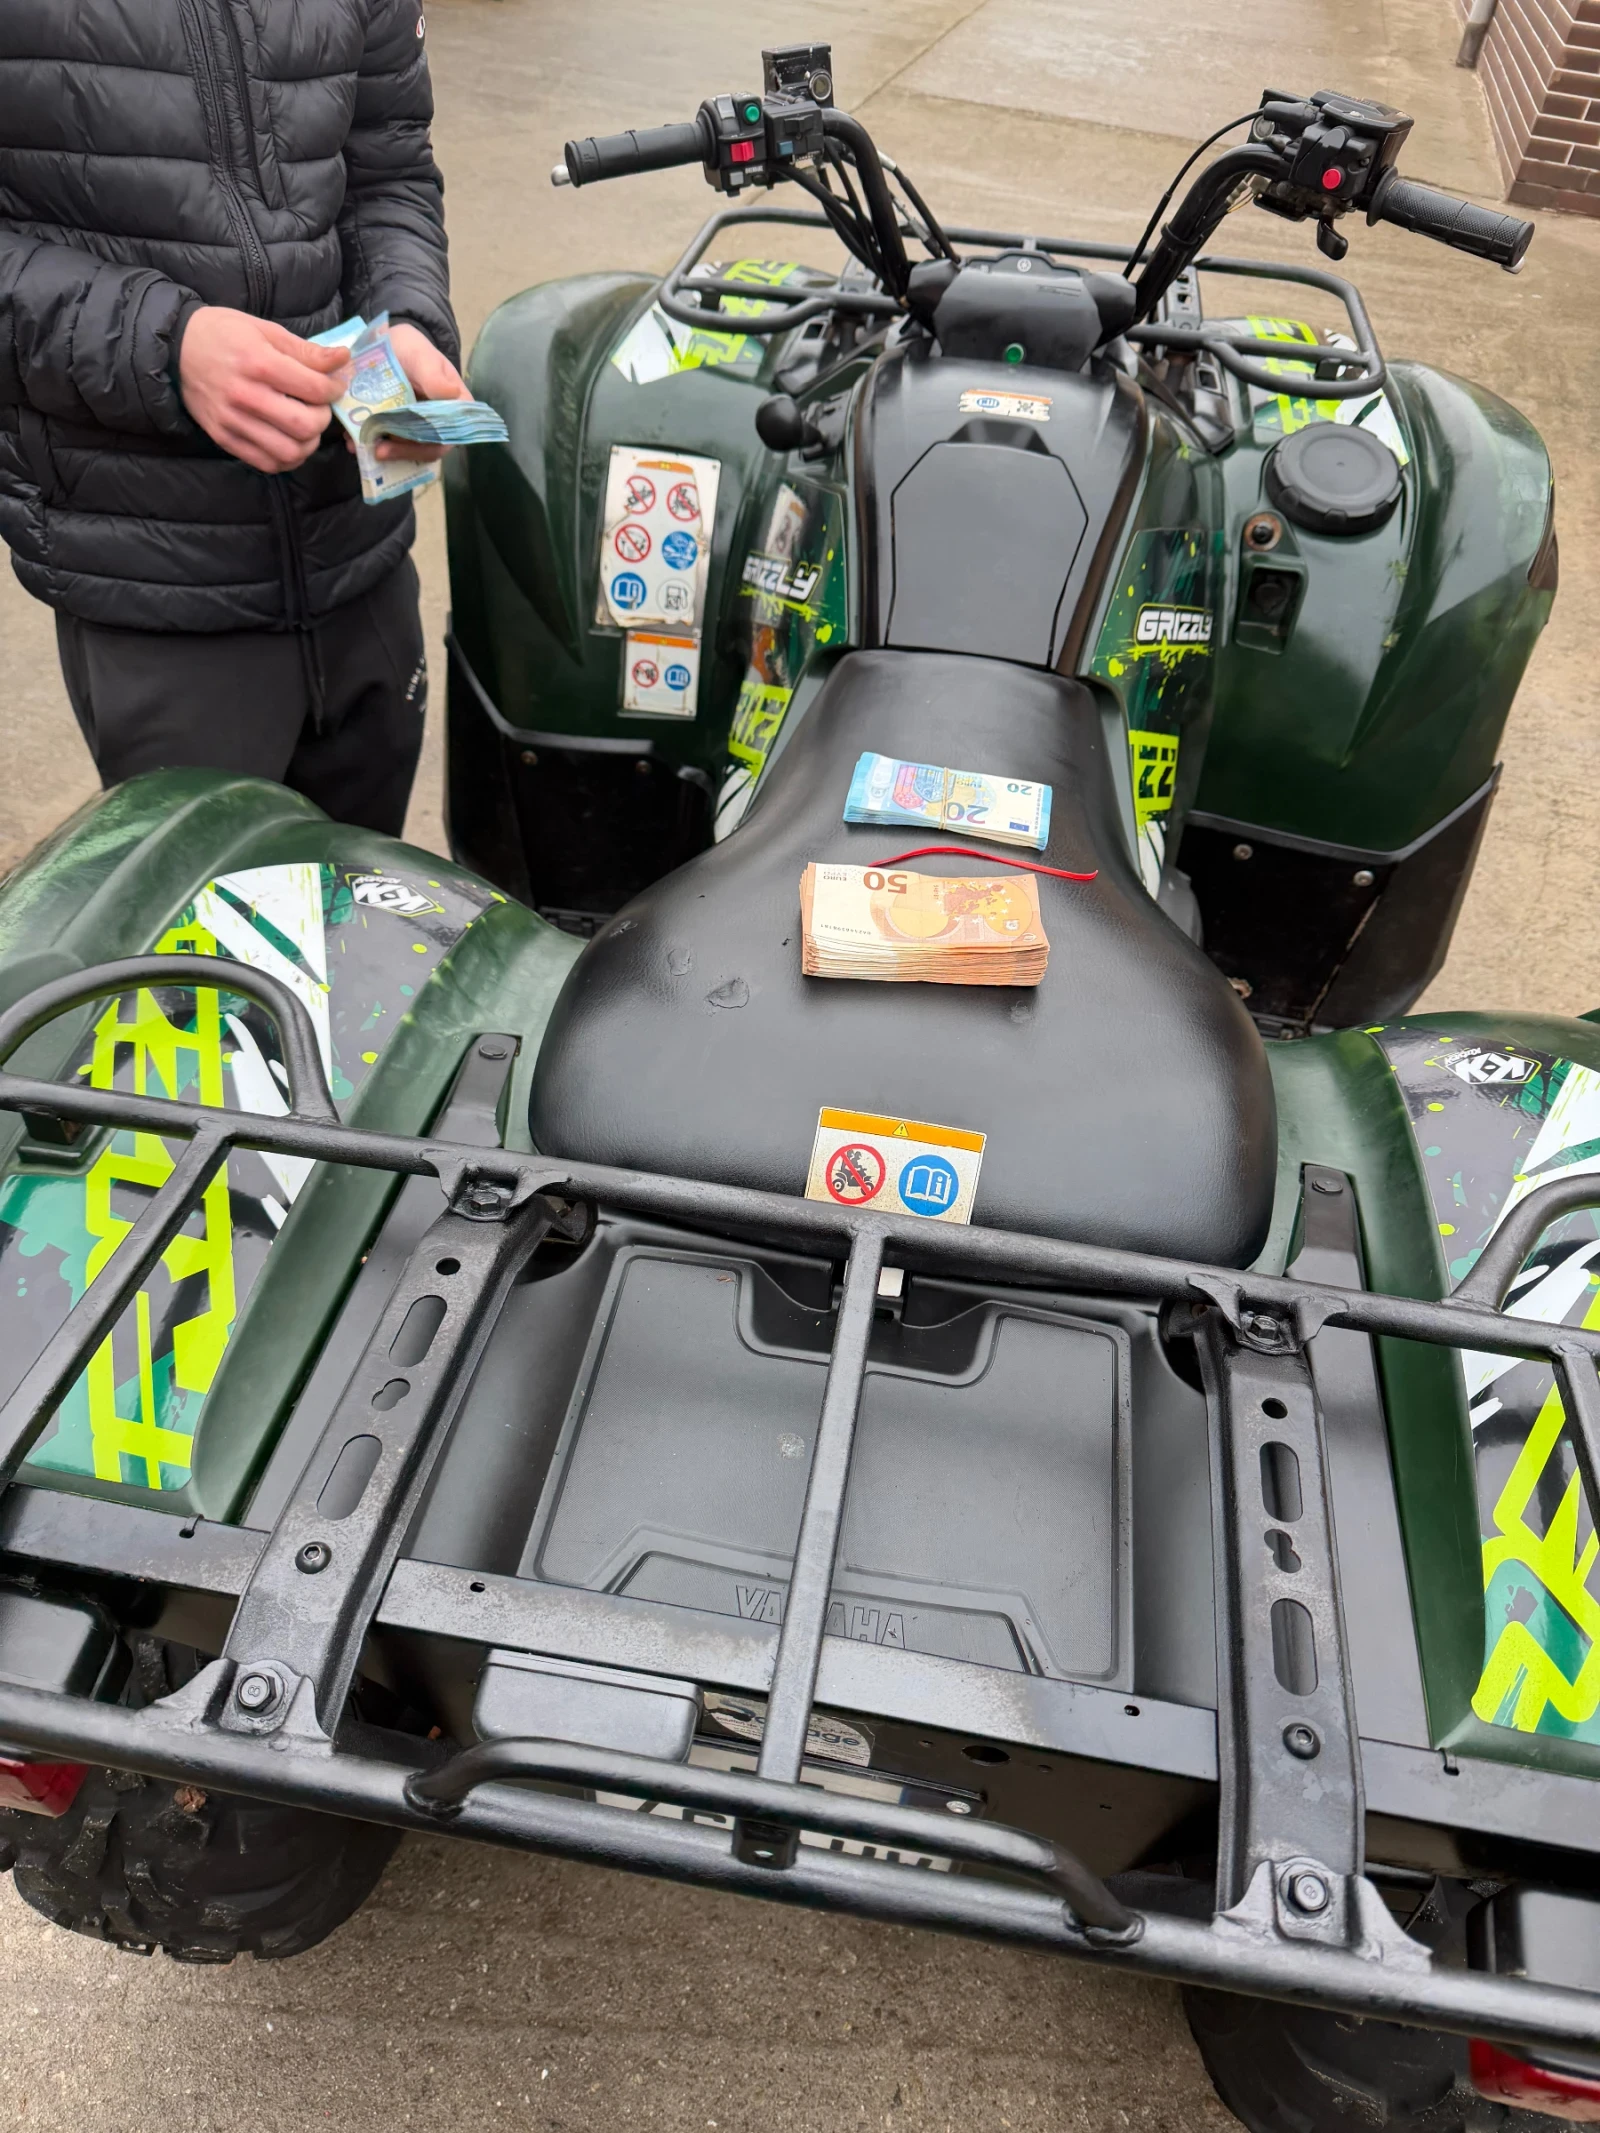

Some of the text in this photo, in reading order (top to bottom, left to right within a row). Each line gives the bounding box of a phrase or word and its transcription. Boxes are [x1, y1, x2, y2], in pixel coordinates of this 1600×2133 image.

[1137, 610, 1214, 641] GRIZZLY
[1007, 782, 1033, 796] 20
[946, 801, 990, 825] 20
[863, 871, 908, 895] 50
[736, 1584, 906, 1649] YAAHA
